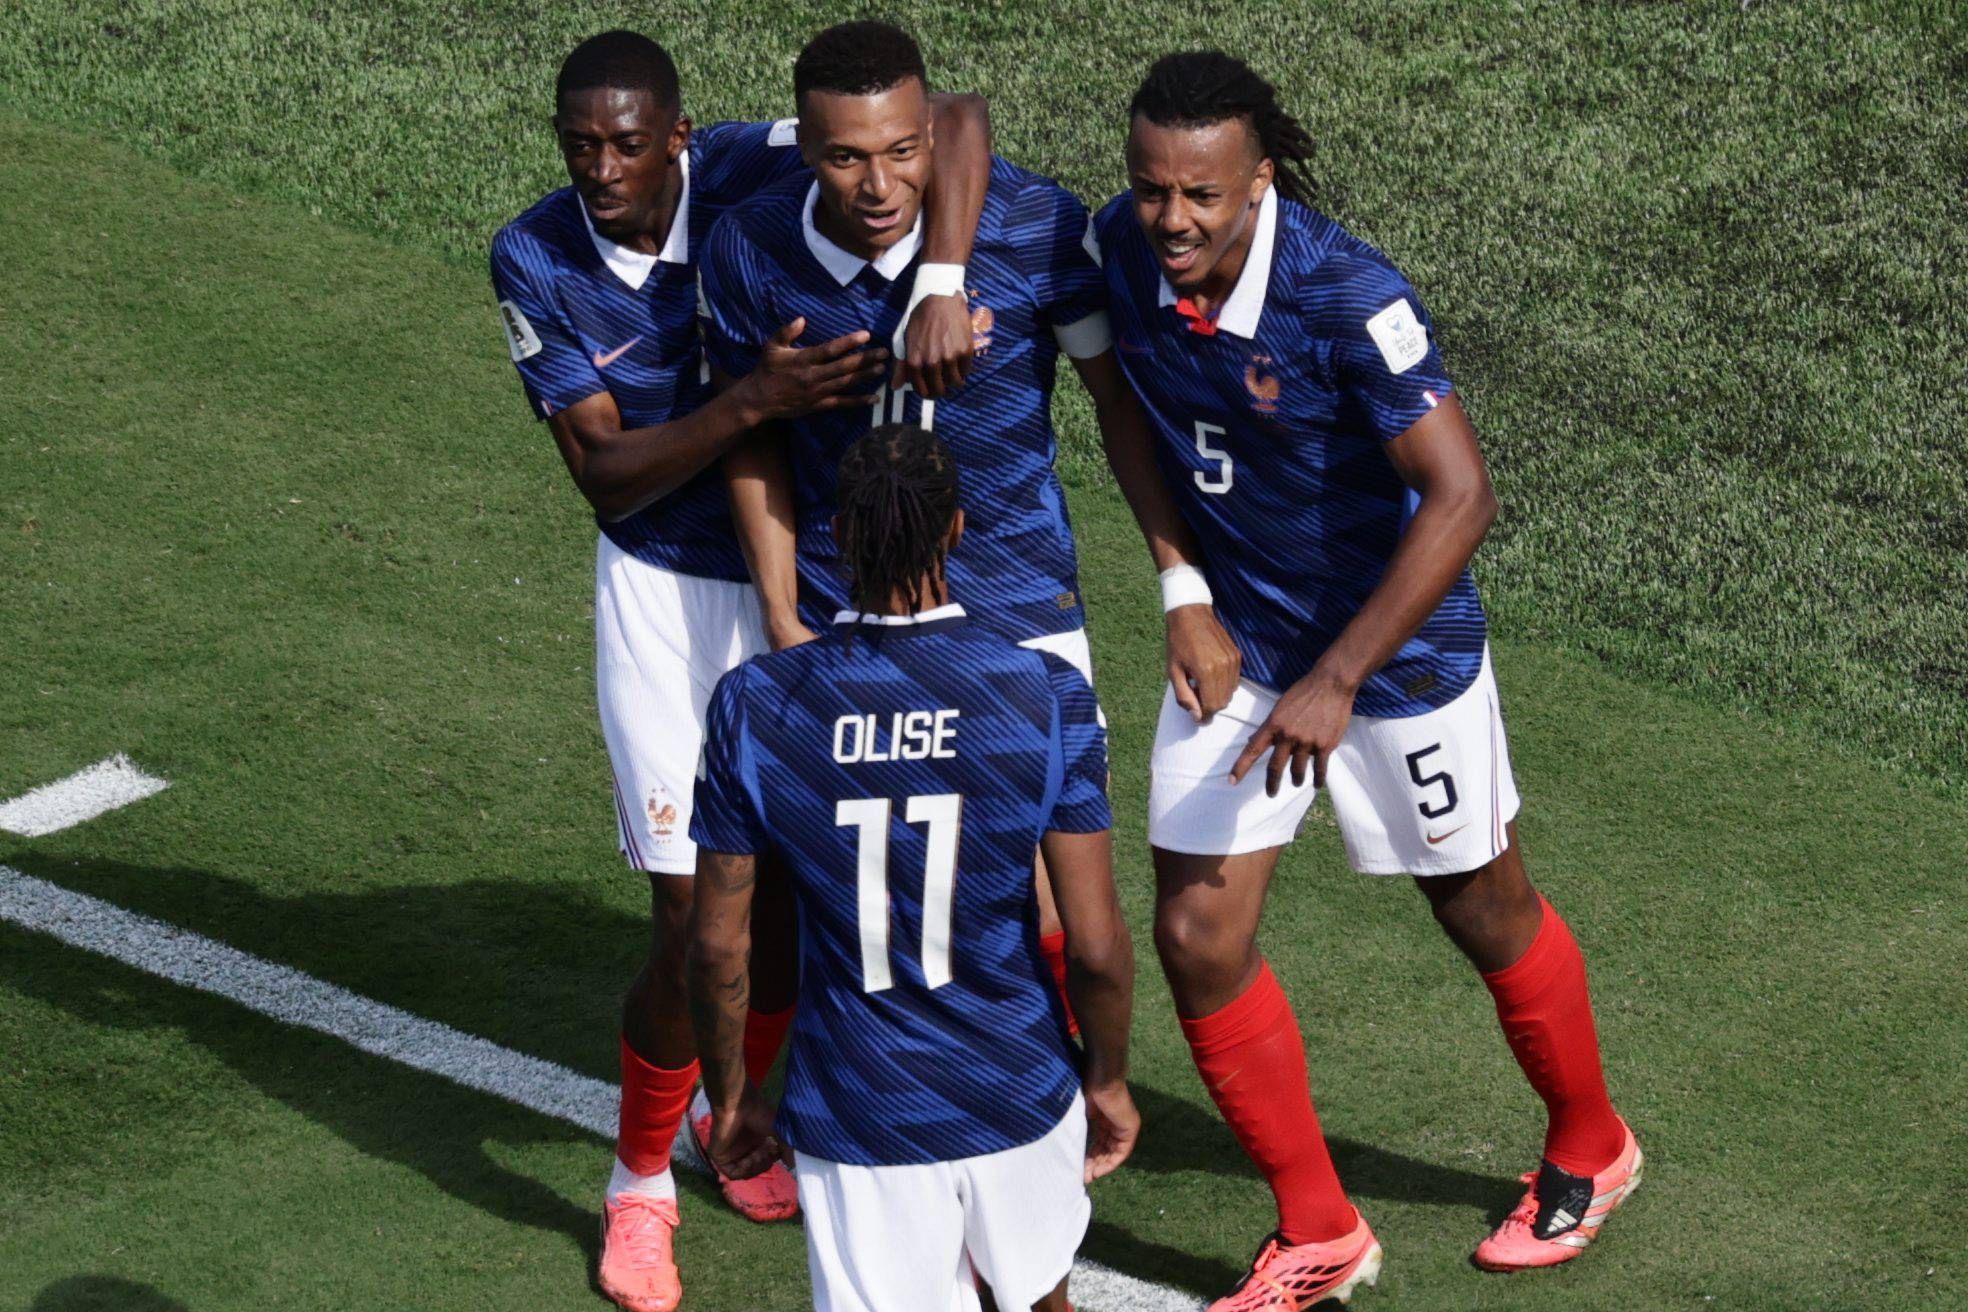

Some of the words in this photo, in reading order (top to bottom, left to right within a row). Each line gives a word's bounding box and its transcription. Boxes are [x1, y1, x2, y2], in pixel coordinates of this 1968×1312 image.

[1194, 420, 1233, 494] 5
[833, 709, 960, 764] OLISE
[1405, 741, 1459, 820] 5
[836, 793, 963, 993] 11
